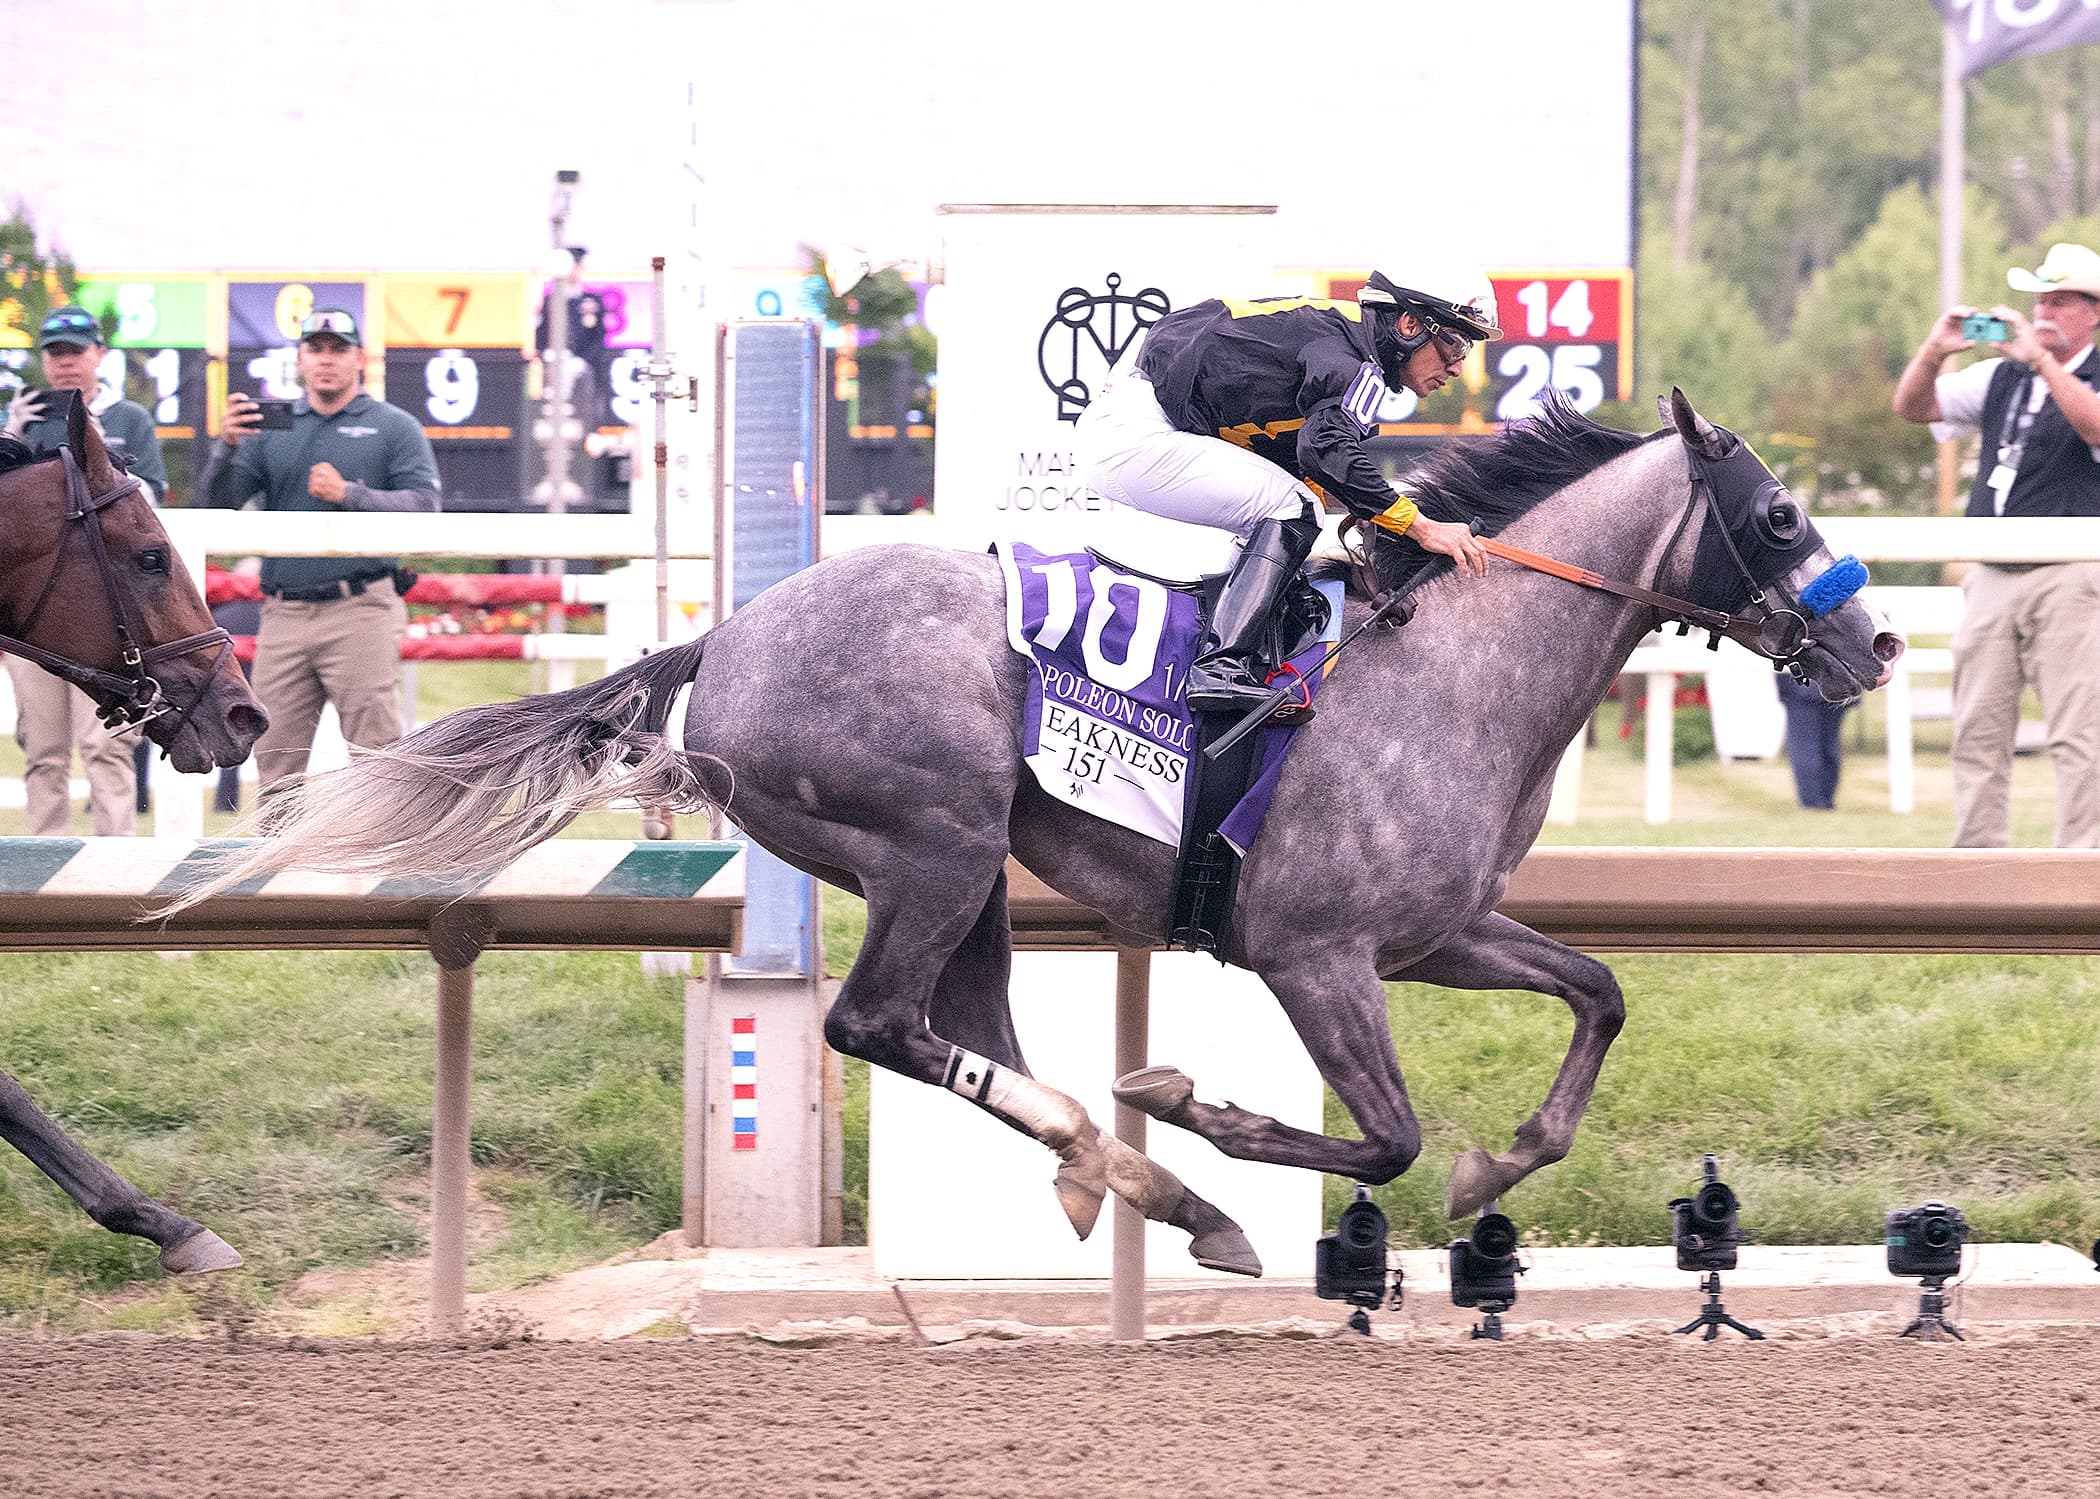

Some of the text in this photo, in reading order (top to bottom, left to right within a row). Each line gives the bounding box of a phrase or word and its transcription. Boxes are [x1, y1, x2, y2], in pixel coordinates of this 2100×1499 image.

[118, 283, 157, 341] 5
[437, 287, 472, 336] 7
[1517, 279, 1594, 338] 14
[425, 348, 480, 425] 9
[1347, 366, 1386, 425] 10
[1496, 344, 1605, 422] 25
[1030, 560, 1168, 692] 10
[1046, 705, 1185, 783] EAKNESS
[1062, 746, 1107, 785] 151
